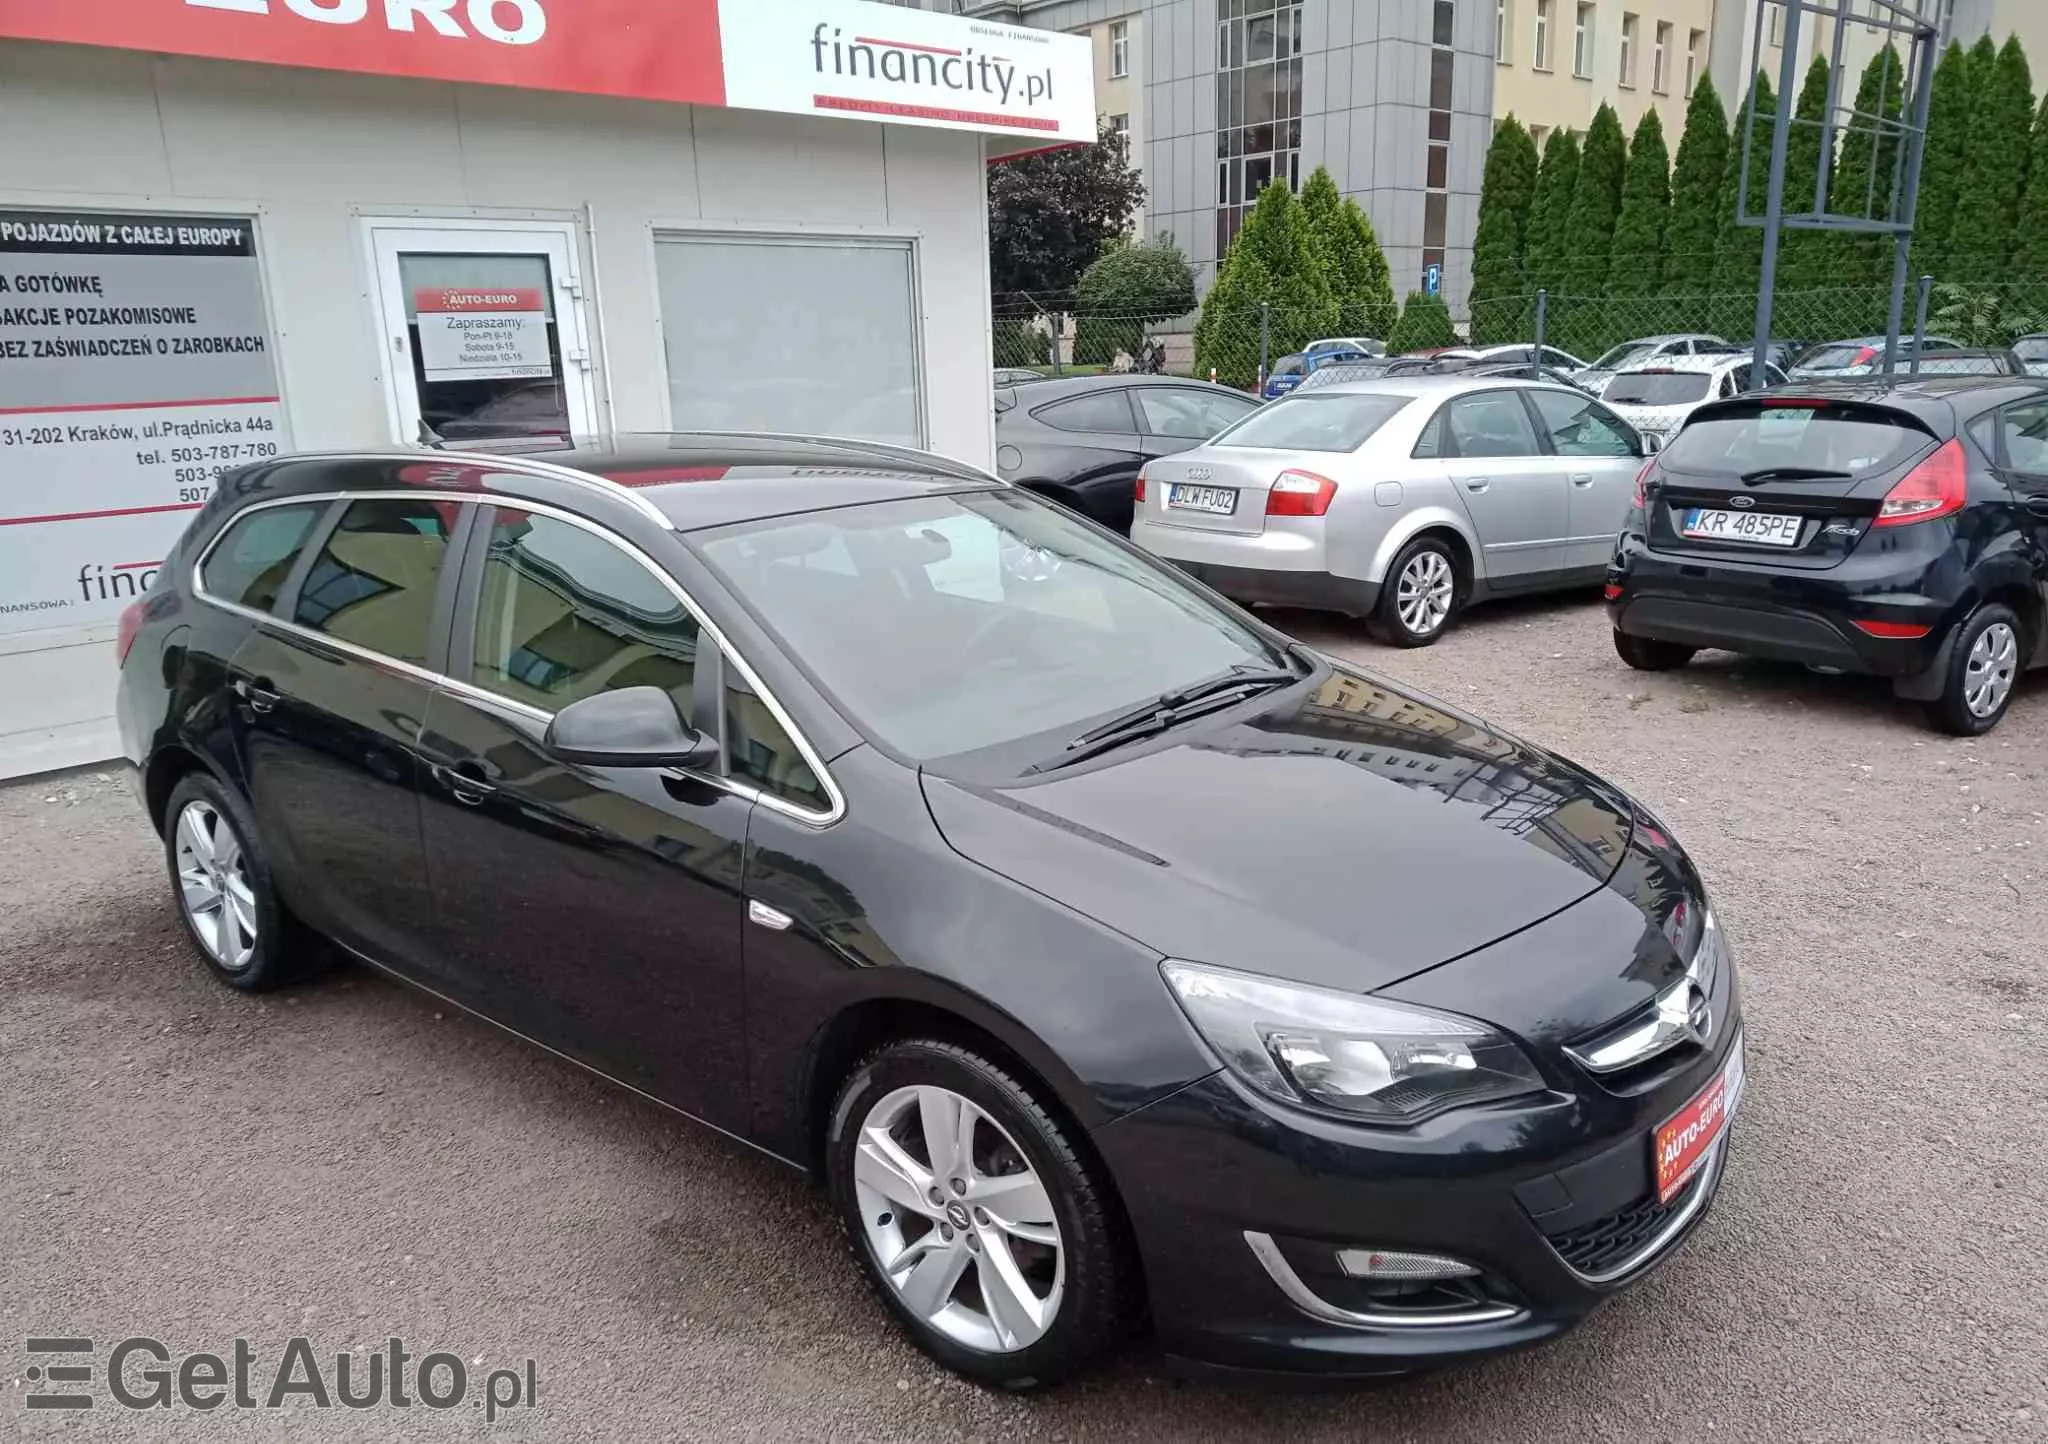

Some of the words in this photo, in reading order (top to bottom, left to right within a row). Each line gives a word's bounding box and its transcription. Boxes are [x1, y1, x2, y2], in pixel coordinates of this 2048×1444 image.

[811, 22, 1053, 106] financity.pl
[1, 220, 101, 243] POJAZDÓW
[107, 226, 119, 244] Z
[121, 226, 174, 245] CAŁEJ
[178, 227, 242, 246] EUROPY
[15, 271, 103, 297] GOTÓWKĘ
[450, 294, 518, 305] AUTO-EURO
[0, 307, 61, 326] AKCJE
[65, 307, 197, 326] POZAKOMISOWE
[31, 333, 153, 358] ZAŚWIADCZEŃ
[157, 338, 168, 355] O
[172, 336, 265, 355] ZAROBKACH
[4, 427, 63, 446] 31-202
[67, 423, 139, 444] Kraków,
[246, 416, 273, 432] 44a
[136, 449, 166, 465] tel.
[171, 442, 277, 462] 503-787-780
[1698, 511, 1728, 532] KR
[1733, 514, 1797, 540] 485PE
[1663, 1089, 1723, 1167] AUTO-EURO
